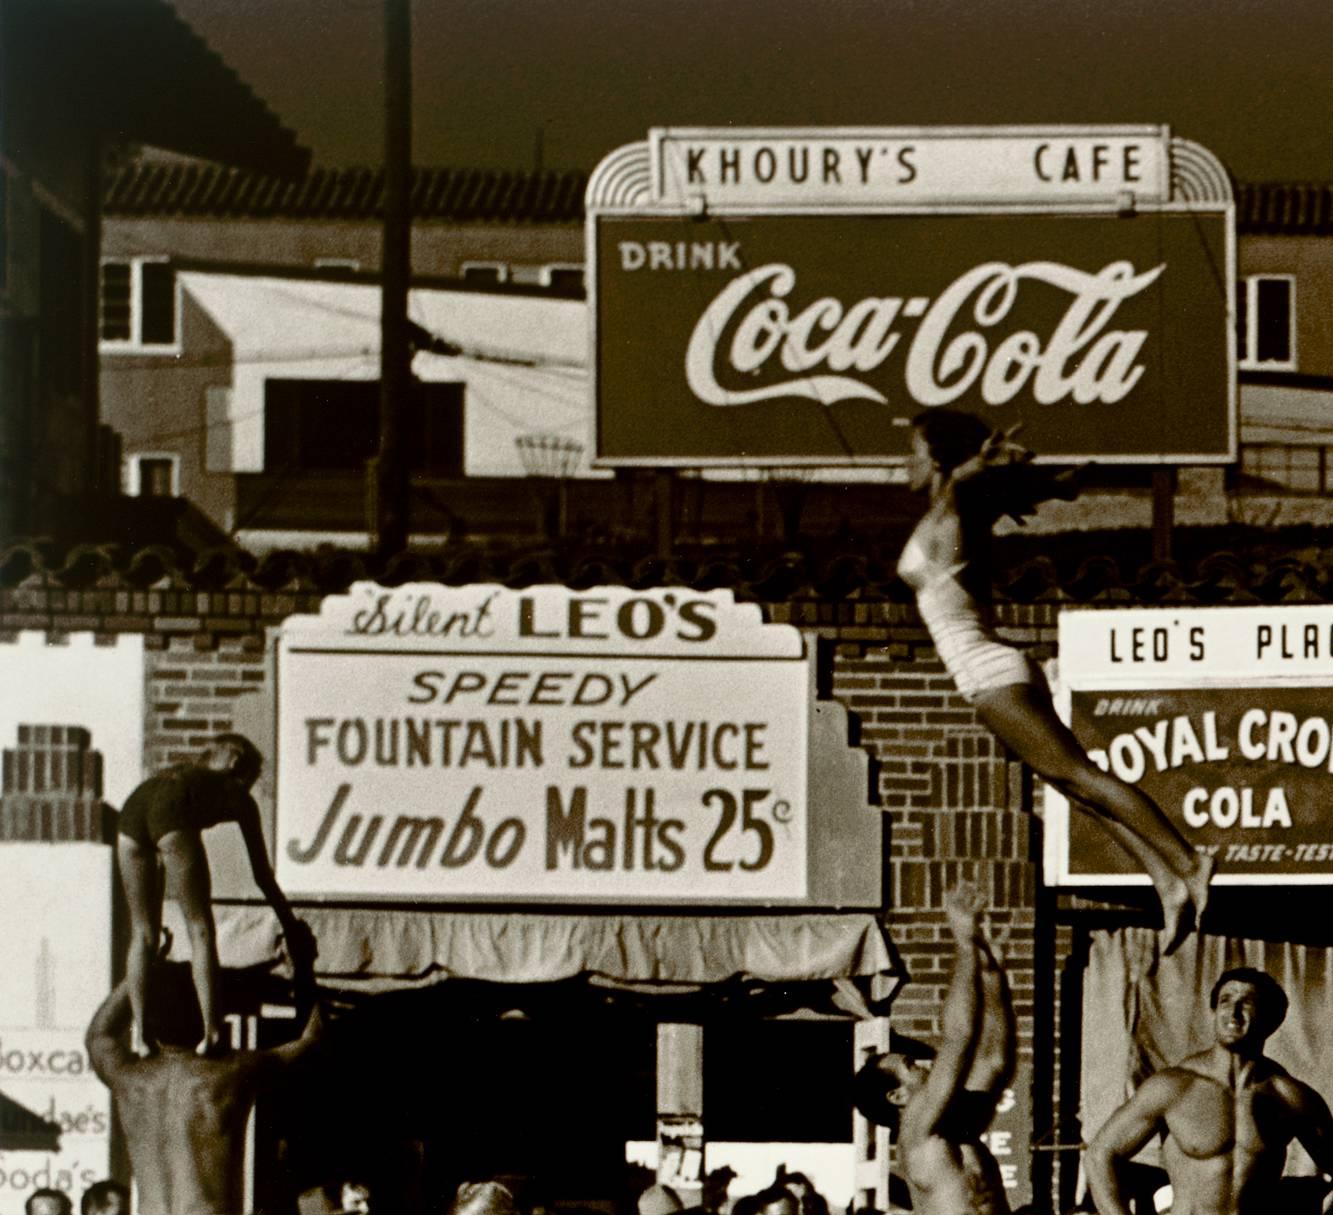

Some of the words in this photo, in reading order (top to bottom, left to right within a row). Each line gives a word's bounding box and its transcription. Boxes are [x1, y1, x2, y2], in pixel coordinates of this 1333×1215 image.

[686, 145, 918, 184] KHOURY'S
[1033, 143, 1143, 182] CAFE
[618, 240, 744, 271] DRINK
[685, 261, 1167, 406] Coca-Cola
[518, 592, 717, 642] LEO'S
[1110, 618, 1205, 663] LEO'S
[407, 670, 660, 707] SPEEDY
[1093, 697, 1162, 716] DRINK
[304, 717, 545, 768] FOUNTAIN
[567, 719, 771, 771] SERVICE
[285, 783, 527, 871] Jumbo
[544, 785, 687, 872] Malts
[1182, 786, 1293, 829] COLA
[0, 1050, 93, 1076] oxca
[0, 1159, 96, 1192] oda's
